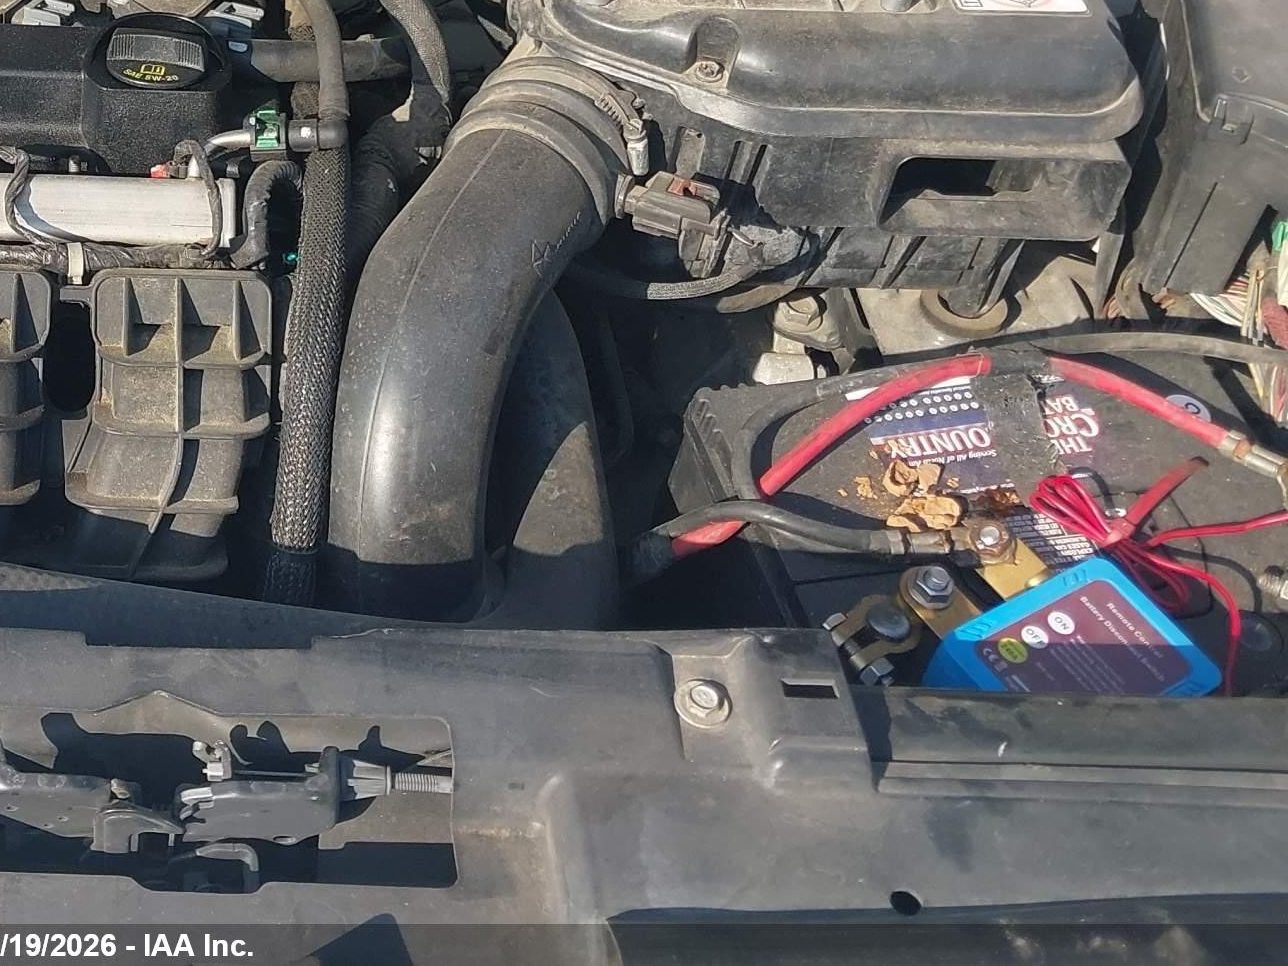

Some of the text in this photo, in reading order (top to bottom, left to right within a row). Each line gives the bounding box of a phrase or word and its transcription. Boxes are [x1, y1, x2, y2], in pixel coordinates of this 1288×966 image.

[122, 68, 144, 80] SAE
[890, 427, 992, 459] OUNTRY
[945, 449, 998, 463] Serving All of
[1079, 596, 1106, 622] Battery
[1106, 602, 1136, 633] Remote
[1054, 616, 1071, 631] ON
[1025, 627, 1046, 647] OFF
